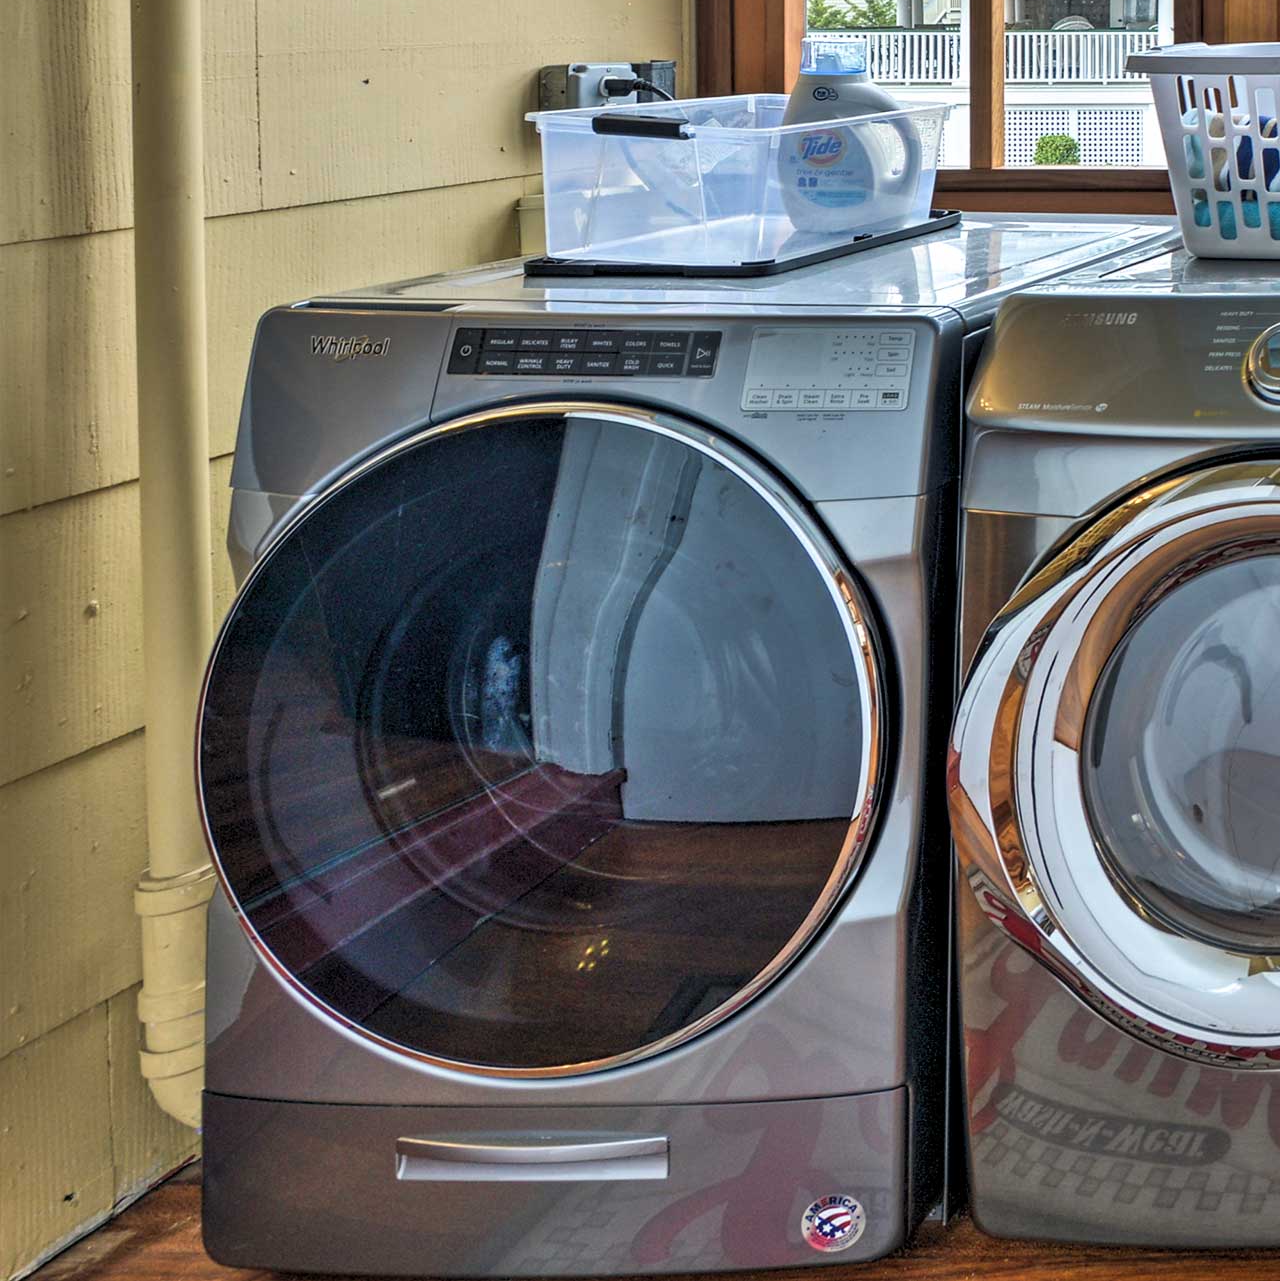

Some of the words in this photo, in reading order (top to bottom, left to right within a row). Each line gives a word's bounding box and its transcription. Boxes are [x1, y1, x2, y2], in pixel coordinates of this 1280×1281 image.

[802, 135, 842, 160] Tide
[311, 335, 391, 360] Whirlpool
[805, 1196, 858, 1223] AMERICA
